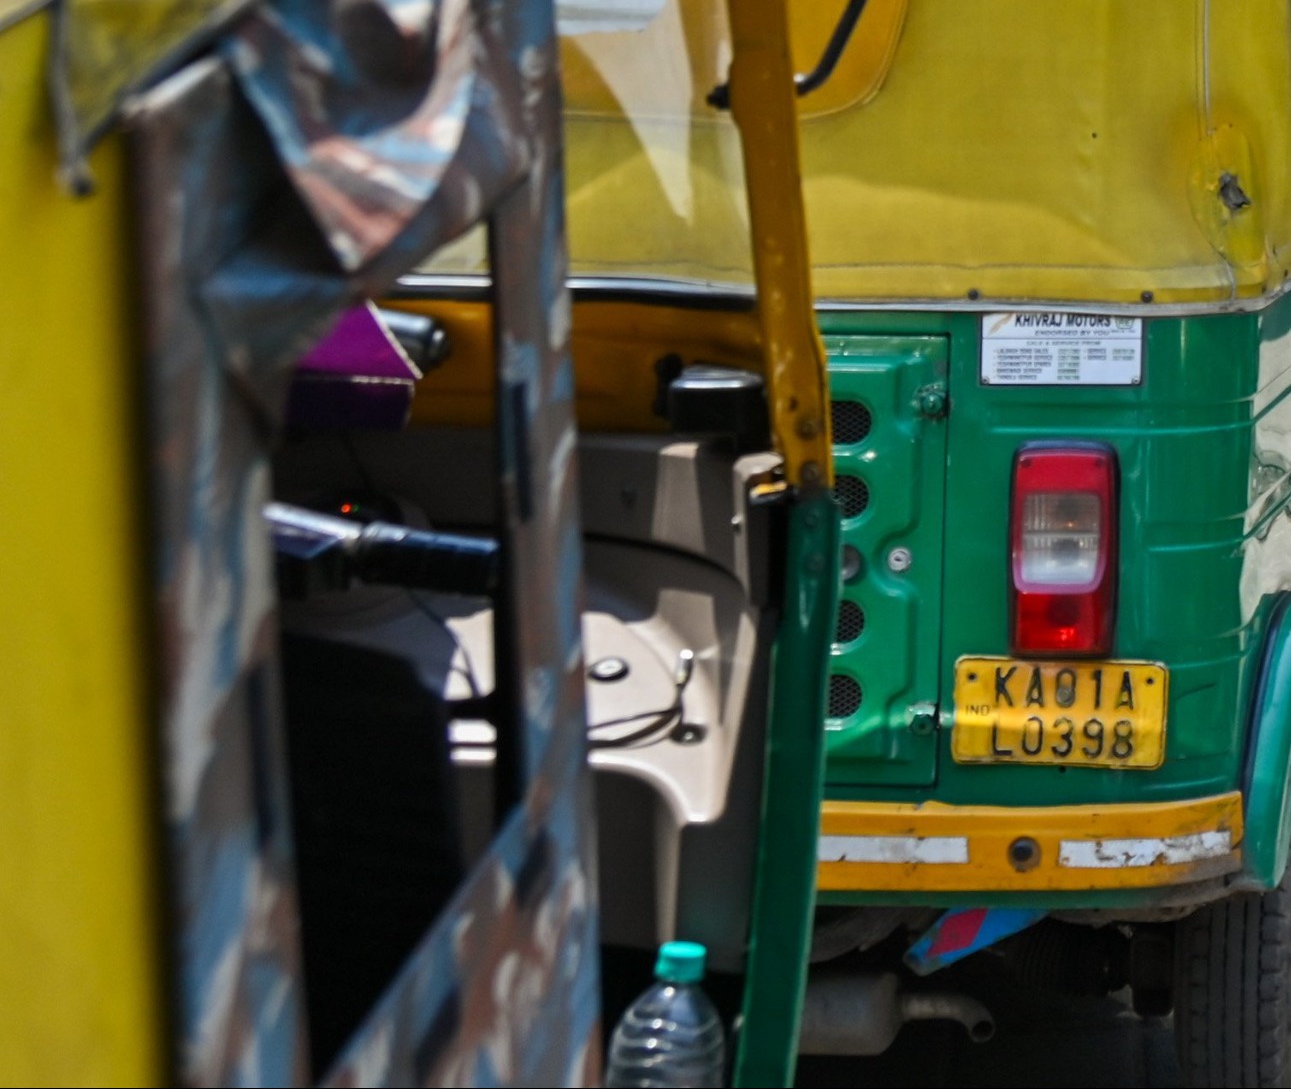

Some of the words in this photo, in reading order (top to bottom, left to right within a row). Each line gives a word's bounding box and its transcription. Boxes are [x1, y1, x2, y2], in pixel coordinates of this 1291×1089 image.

[1015, 314, 1064, 328] KHIVRAJ
[1066, 316, 1111, 328] MOTORS
[995, 667, 1134, 710] KA01A
[965, 704, 990, 716] IND
[992, 716, 1134, 759] L0398
